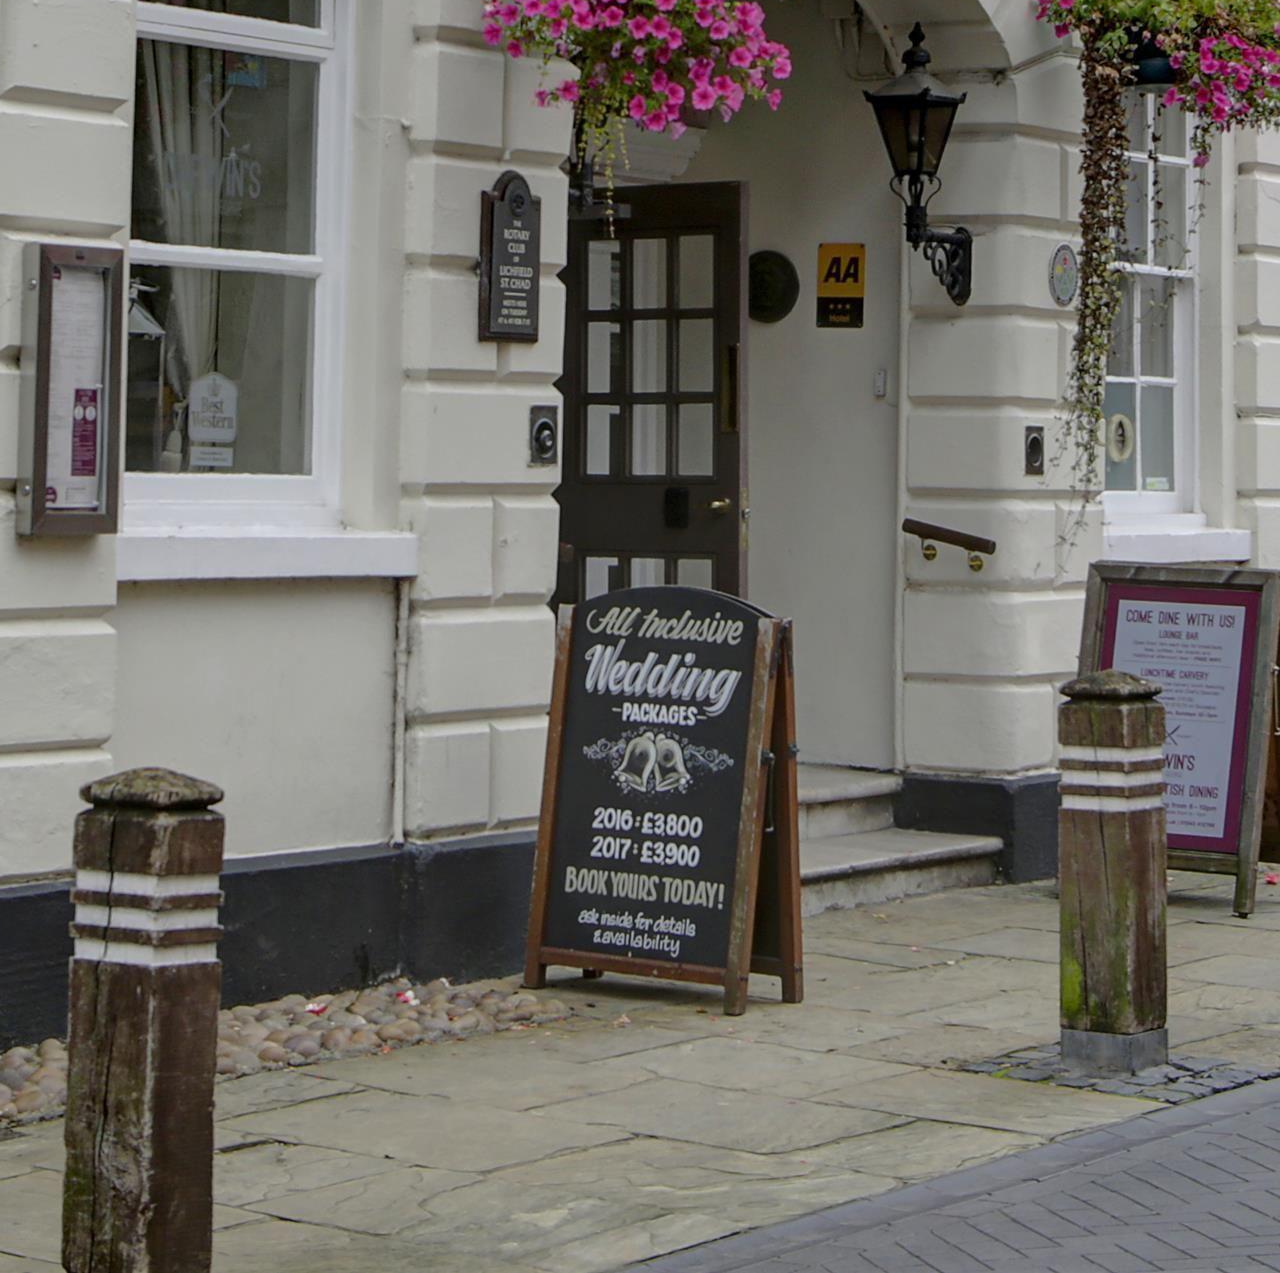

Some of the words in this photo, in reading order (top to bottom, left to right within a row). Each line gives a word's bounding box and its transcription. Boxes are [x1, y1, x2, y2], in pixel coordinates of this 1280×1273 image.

[503, 229, 531, 240] ROTARY
[507, 242, 526, 254] CLUB
[823, 256, 859, 283] AA
[586, 606, 641, 637] All
[638, 609, 744, 645] Inclusive
[1126, 609, 1153, 624] COME
[1158, 611, 1180, 625] DINE
[1186, 612, 1214, 627] WITH
[1219, 615, 1235, 628] US!
[584, 638, 742, 717] Wedding
[564, 865, 609, 896] BOOK
[610, 871, 660, 902] YOURS
[662, 877, 725, 910] TODAY!
[578, 907, 599, 925] ask
[600, 911, 633, 929] inside
[634, 912, 653, 931] for
[653, 915, 696, 937] details
